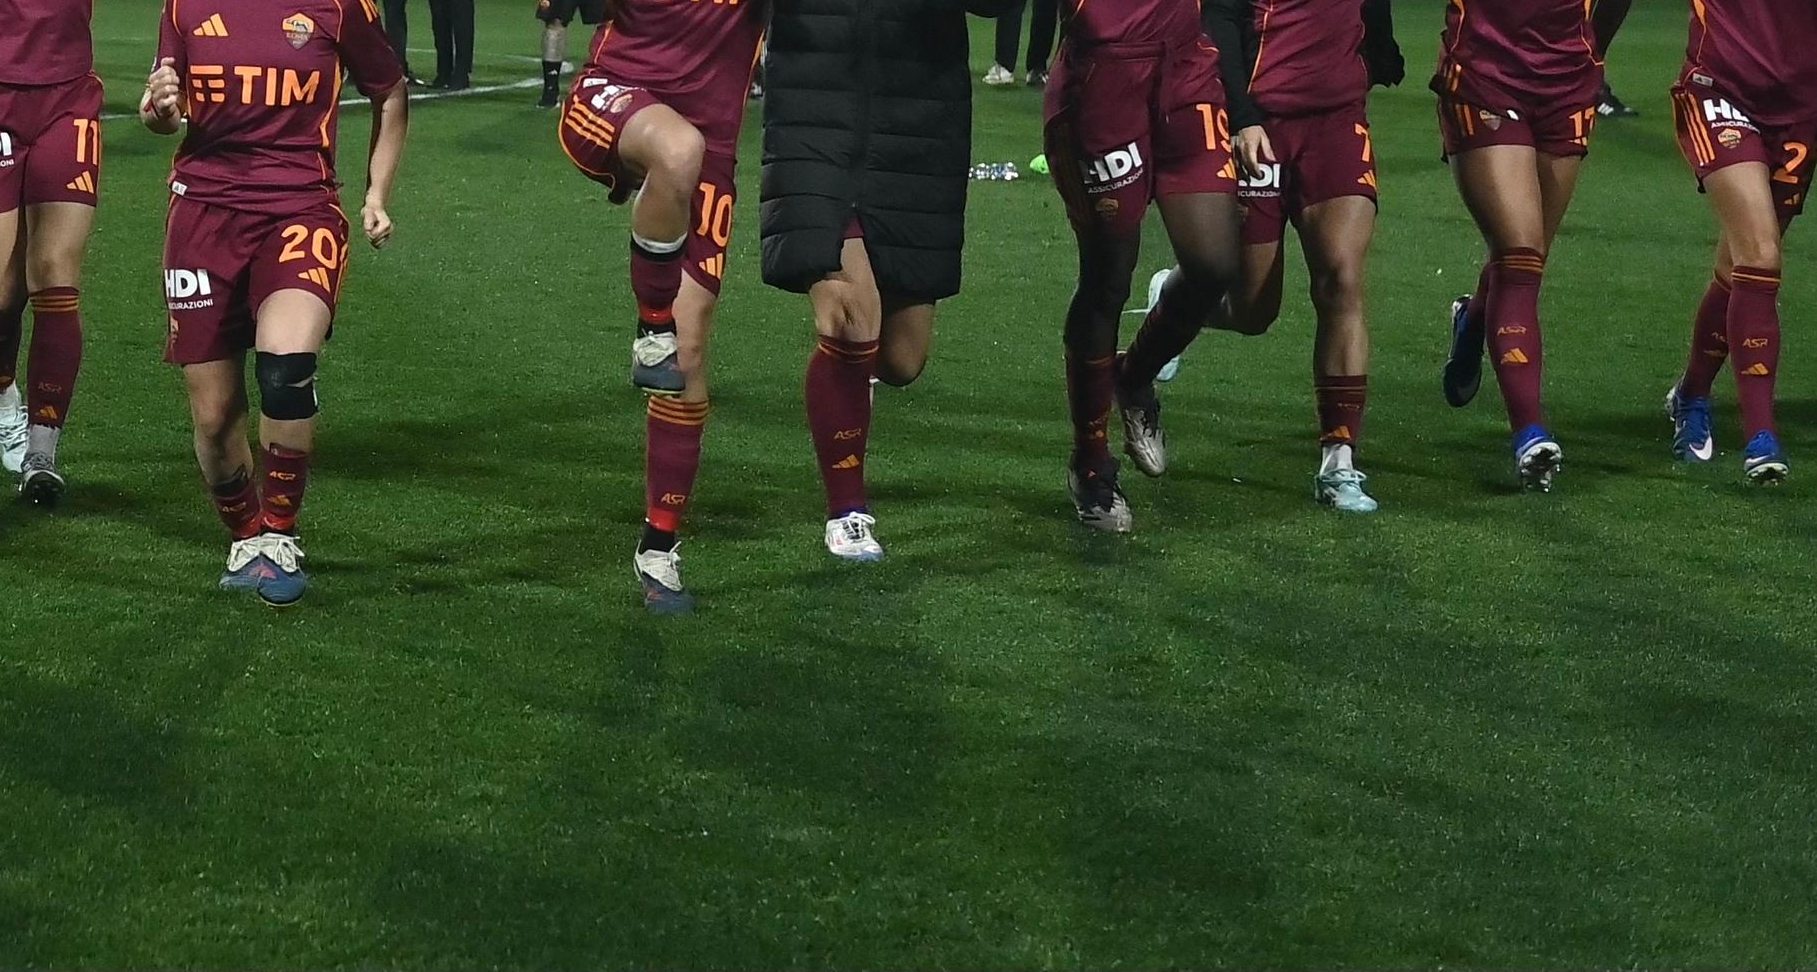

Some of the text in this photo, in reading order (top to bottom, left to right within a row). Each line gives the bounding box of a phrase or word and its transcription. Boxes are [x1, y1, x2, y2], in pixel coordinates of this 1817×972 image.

[235, 65, 320, 106] TIM
[74, 118, 99, 166] 11
[1238, 163, 1281, 188] DI
[1772, 142, 1808, 185] 2
[697, 182, 733, 247] 10
[279, 224, 337, 270] 20
[164, 268, 211, 298] HDI
[1742, 338, 1768, 349] ASR
[834, 428, 862, 440] ASR
[661, 492, 686, 505] ASR
